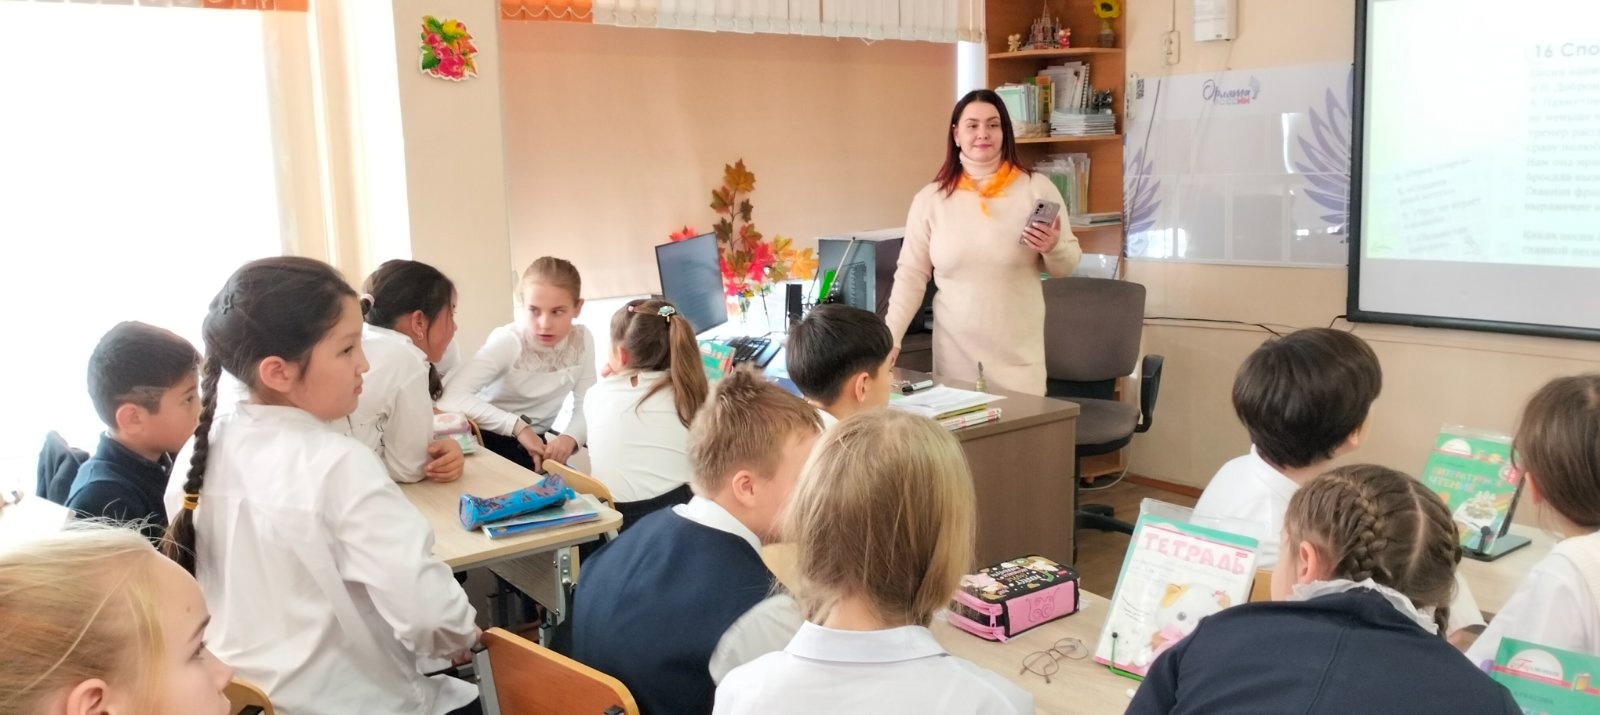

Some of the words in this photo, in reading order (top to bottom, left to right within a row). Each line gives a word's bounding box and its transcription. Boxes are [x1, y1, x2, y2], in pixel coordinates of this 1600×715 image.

[1535, 44, 1553, 58] 16
[1560, 42, 1600, 57] Спо
[1144, 532, 1246, 576] ТЕТРАДЬ
